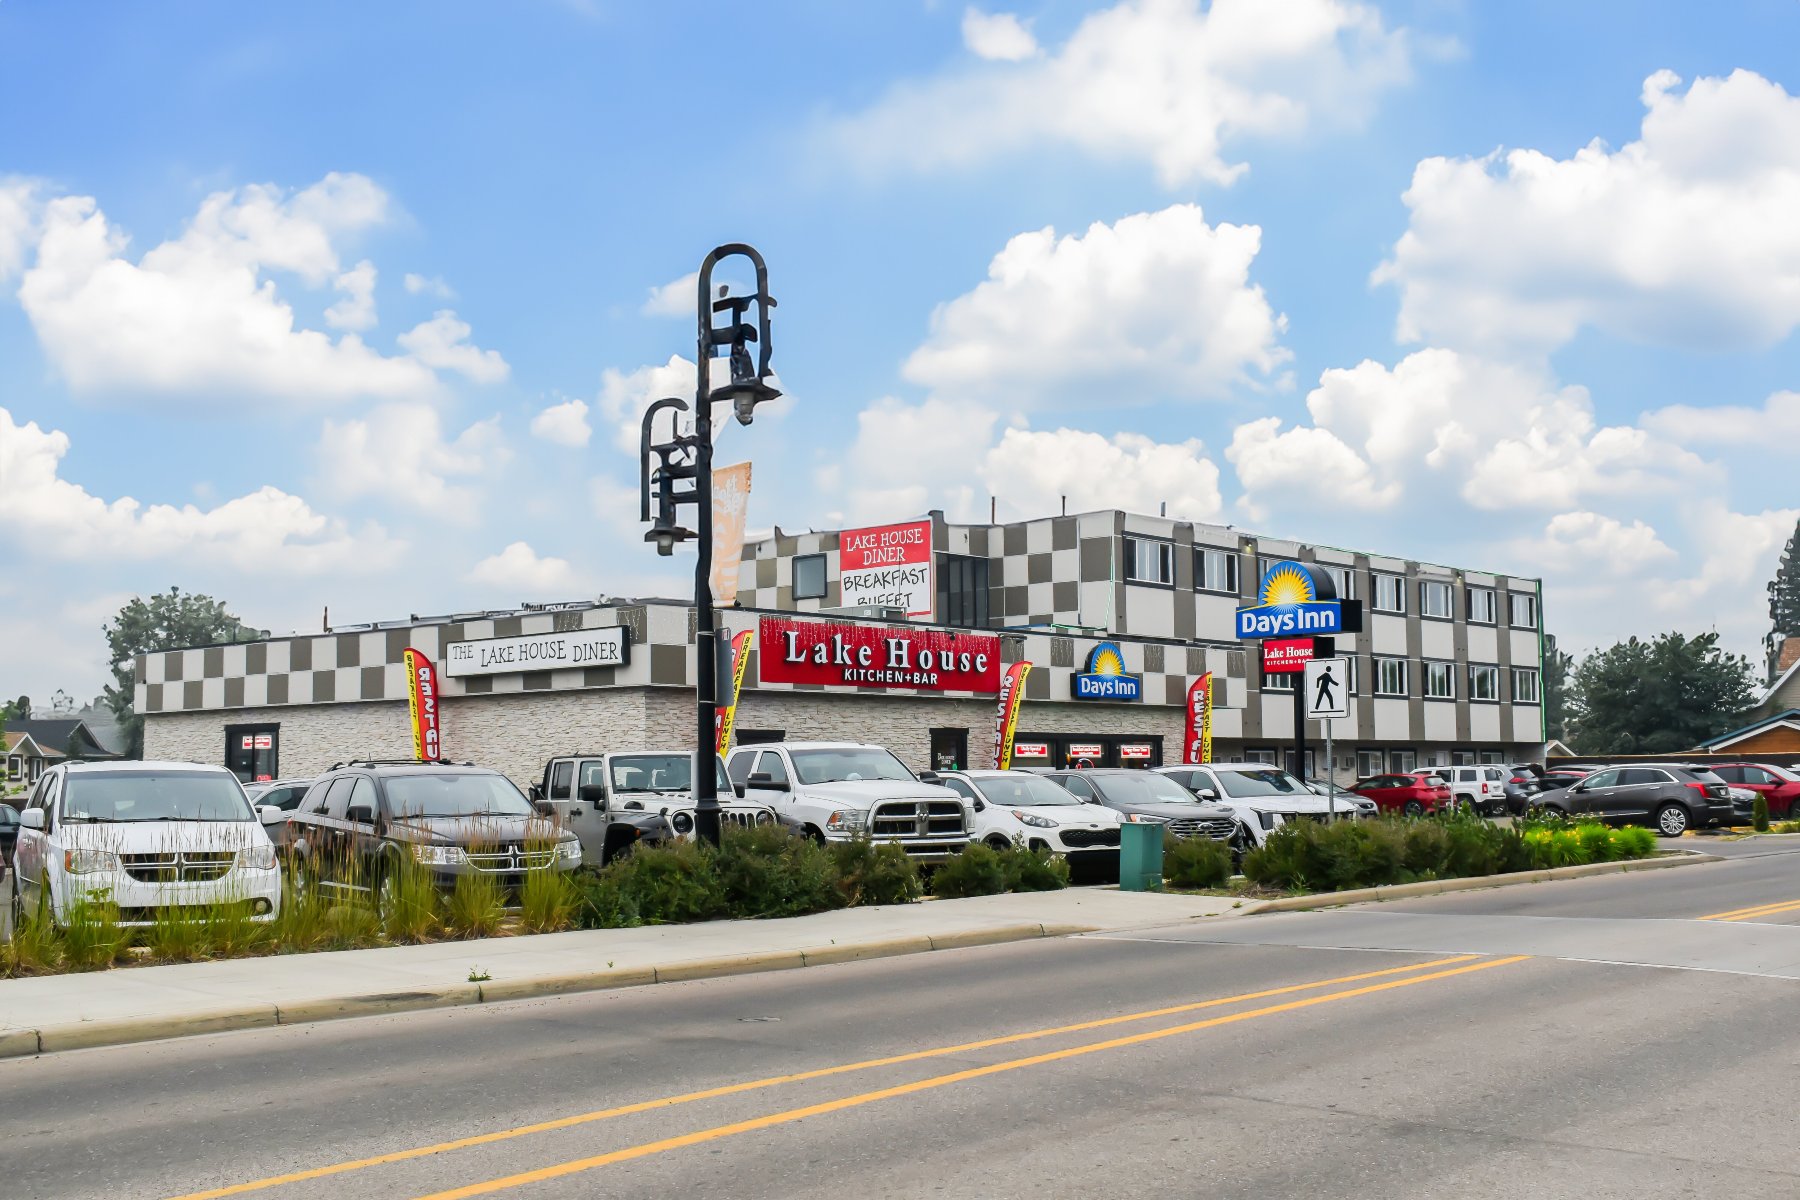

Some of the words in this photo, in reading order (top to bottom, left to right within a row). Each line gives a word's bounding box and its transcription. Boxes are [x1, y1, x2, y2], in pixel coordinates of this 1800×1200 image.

[846, 534, 878, 552] LAKE
[880, 528, 924, 547] HOUSE
[863, 546, 906, 566] DINER
[843, 568, 928, 592] BREAKFAST
[1242, 612, 1295, 634] Days
[1297, 608, 1335, 629] Inn
[452, 645, 474, 660] THE
[481, 645, 515, 667] LAKE
[518, 640, 567, 662] HOUSE
[572, 642, 618, 663] DINER
[784, 630, 872, 667] Lake
[884, 638, 988, 674] House
[1264, 647, 1285, 659] Lake
[1286, 646, 1313, 658] House
[843, 669, 938, 685] KITCHEN+BAR
[1081, 677, 1113, 696] Days
[1114, 679, 1136, 695] Inn
[720, 712, 731, 749] LUNCH
